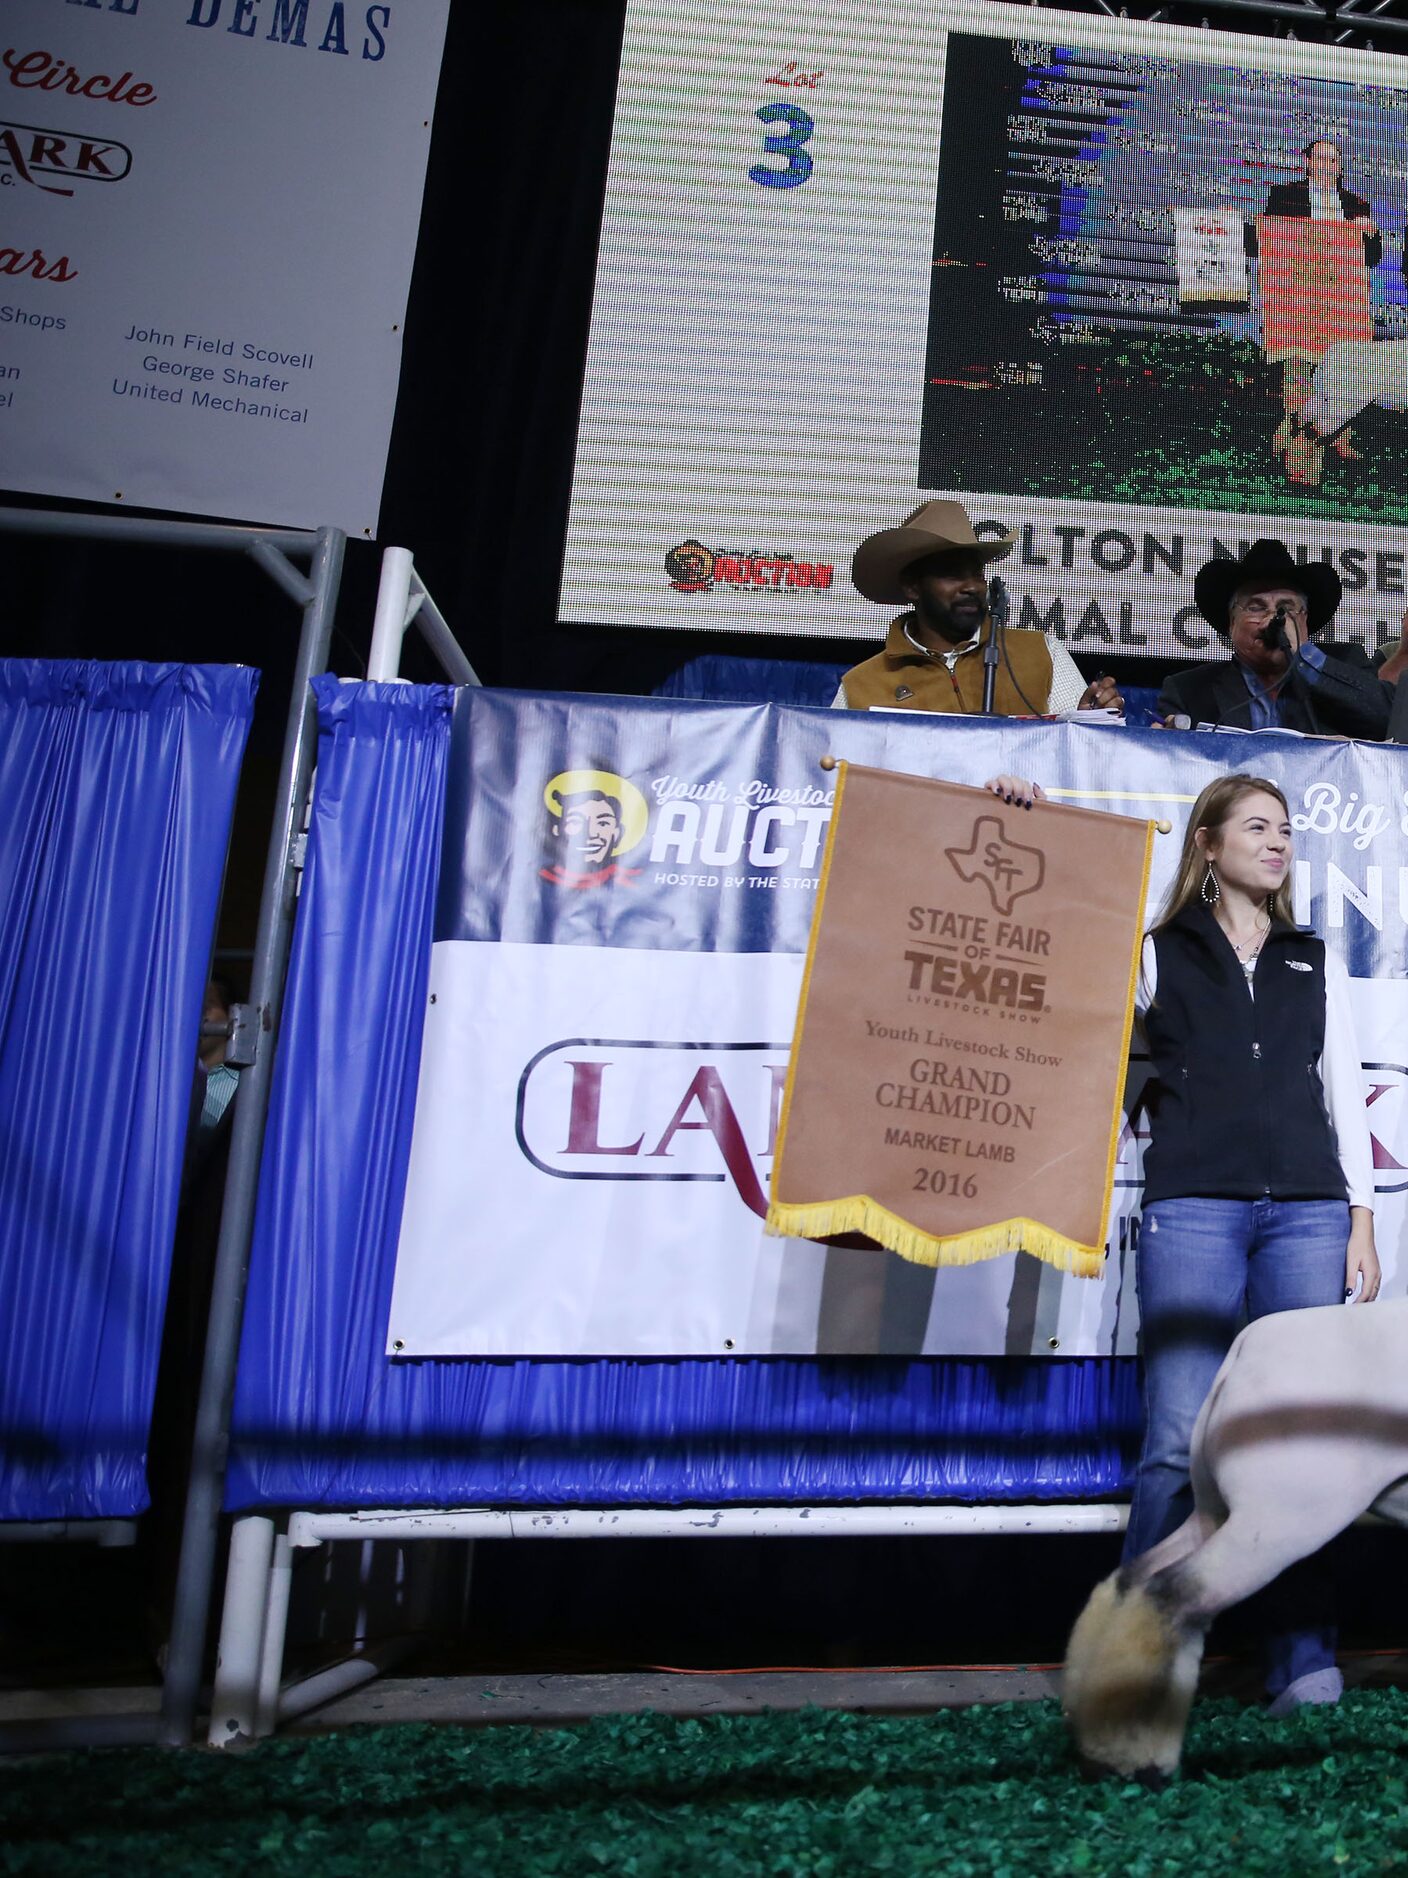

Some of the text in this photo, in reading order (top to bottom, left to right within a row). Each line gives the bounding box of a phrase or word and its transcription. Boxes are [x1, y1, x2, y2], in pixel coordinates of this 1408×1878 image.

[3, 47, 157, 106] Circle
[763, 61, 824, 89] Lot
[748, 103, 814, 189] 3
[0, 306, 67, 331] Shops
[125, 325, 314, 370] John Field Scovell
[143, 355, 290, 393] George Shafer
[112, 378, 309, 424] United Mechanical
[651, 775, 731, 806] Youth
[1292, 782, 1391, 851] Big
[655, 873, 719, 887] HOSTED
[724, 876, 745, 889] BY
[749, 876, 780, 889] THE
[984, 841, 1024, 892] SFT
[908, 906, 1051, 956] STATE FAIR
[964, 944, 992, 960] OF
[904, 950, 1047, 1012] TEXAS
[907, 993, 1041, 1025] LIVESTOCK SHOW
[865, 1019, 1063, 1068] Youth Livestock Show
[909, 1057, 1012, 1097] GRAND
[875, 1082, 1036, 1131] CHAMPION
[884, 1127, 1015, 1164] MARKET LAMB
[912, 1166, 979, 1199] 2016
